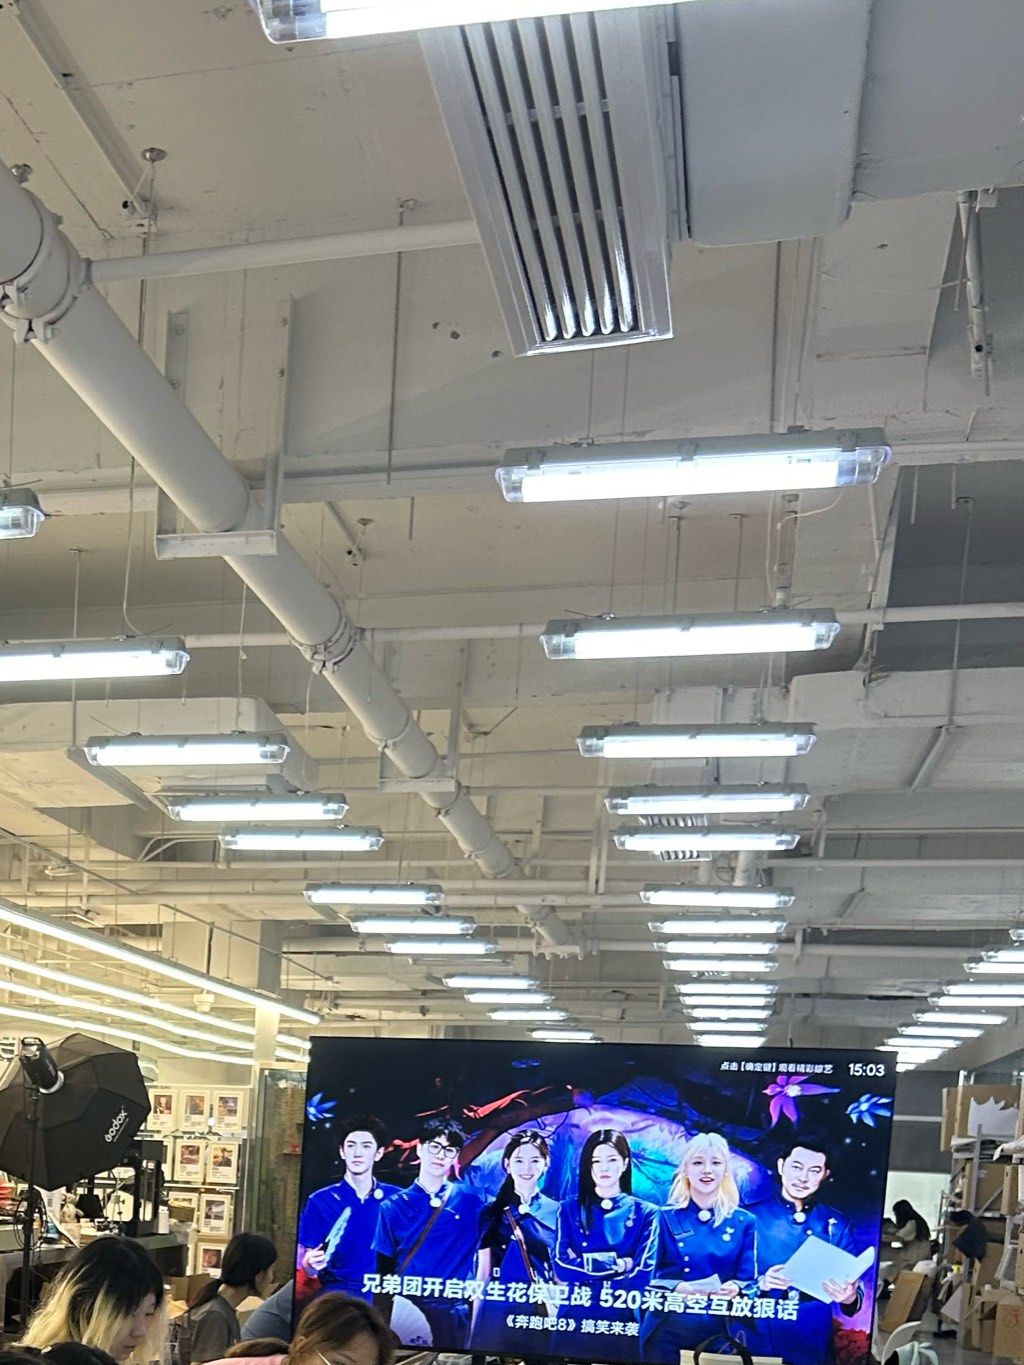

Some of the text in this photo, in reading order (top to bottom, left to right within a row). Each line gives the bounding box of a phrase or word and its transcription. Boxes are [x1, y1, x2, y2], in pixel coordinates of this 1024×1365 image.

[848, 1062, 885, 1077] 15:03
[104, 1109, 128, 1142] Godox
[361, 1273, 800, 1321] 兄弟团开启双生花保卫战 520米高空互放狠话
